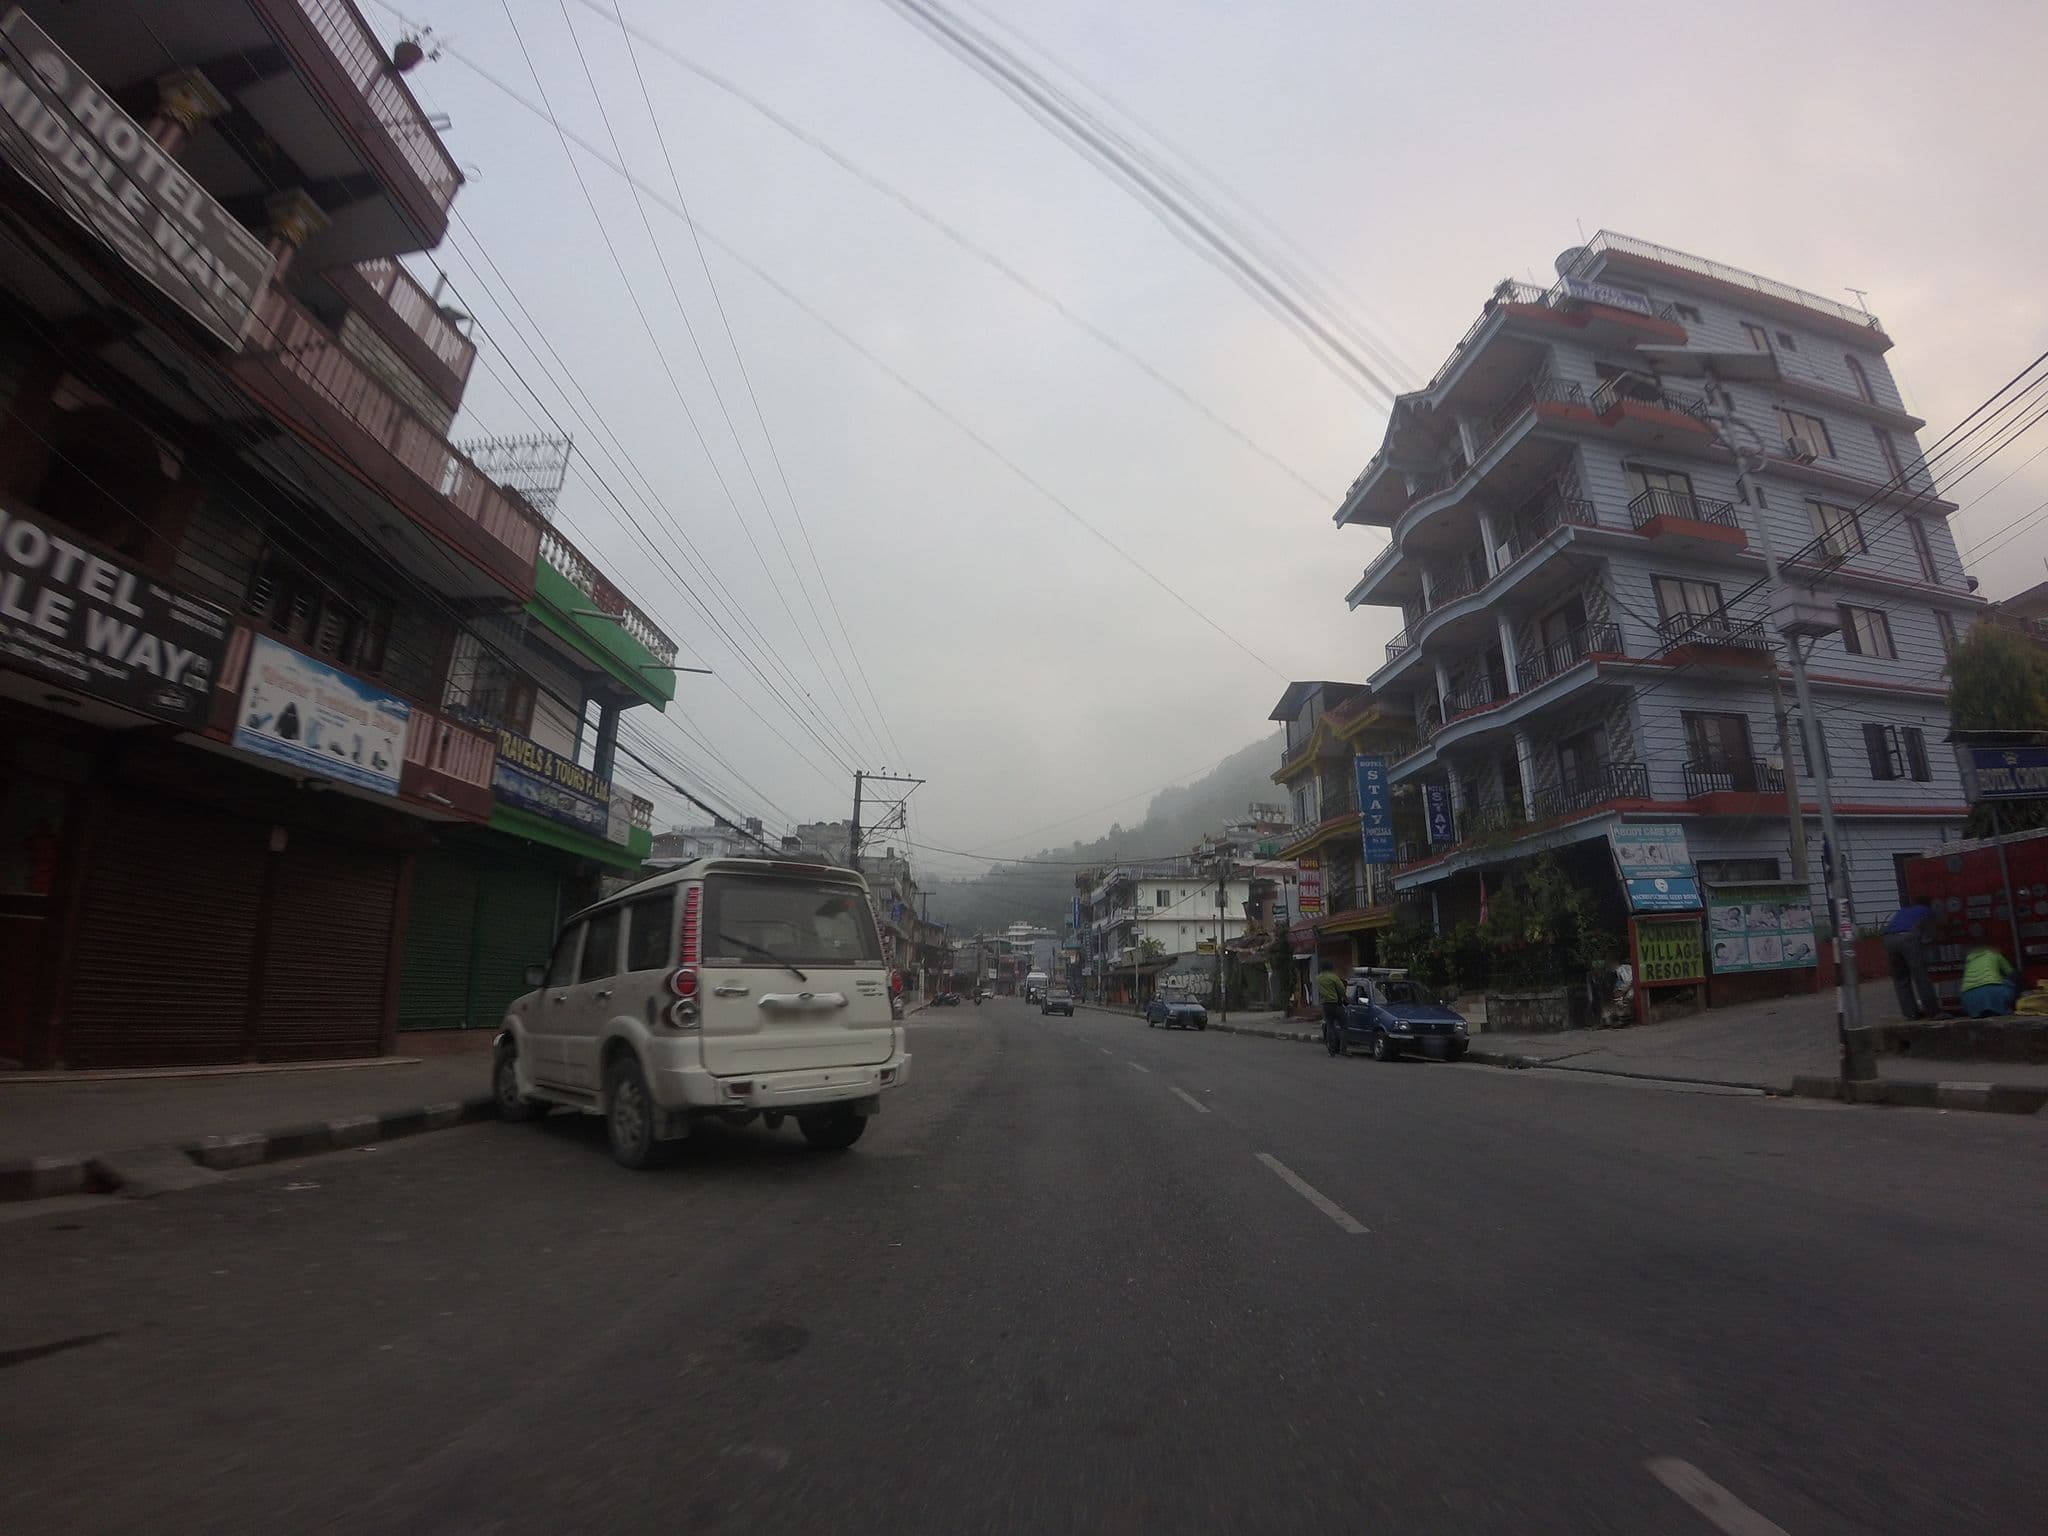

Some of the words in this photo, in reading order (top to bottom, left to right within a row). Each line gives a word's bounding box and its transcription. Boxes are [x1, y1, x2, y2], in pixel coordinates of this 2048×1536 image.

[68, 83, 206, 231] HOTEL
[85, 608, 191, 686] WAY
[498, 730, 543, 772] TRAVELS
[555, 759, 585, 793] TOURS
[1367, 770, 1383, 825] STAY
[1640, 943, 1701, 961] VILLAGE
[1646, 961, 1697, 979] RESORT
